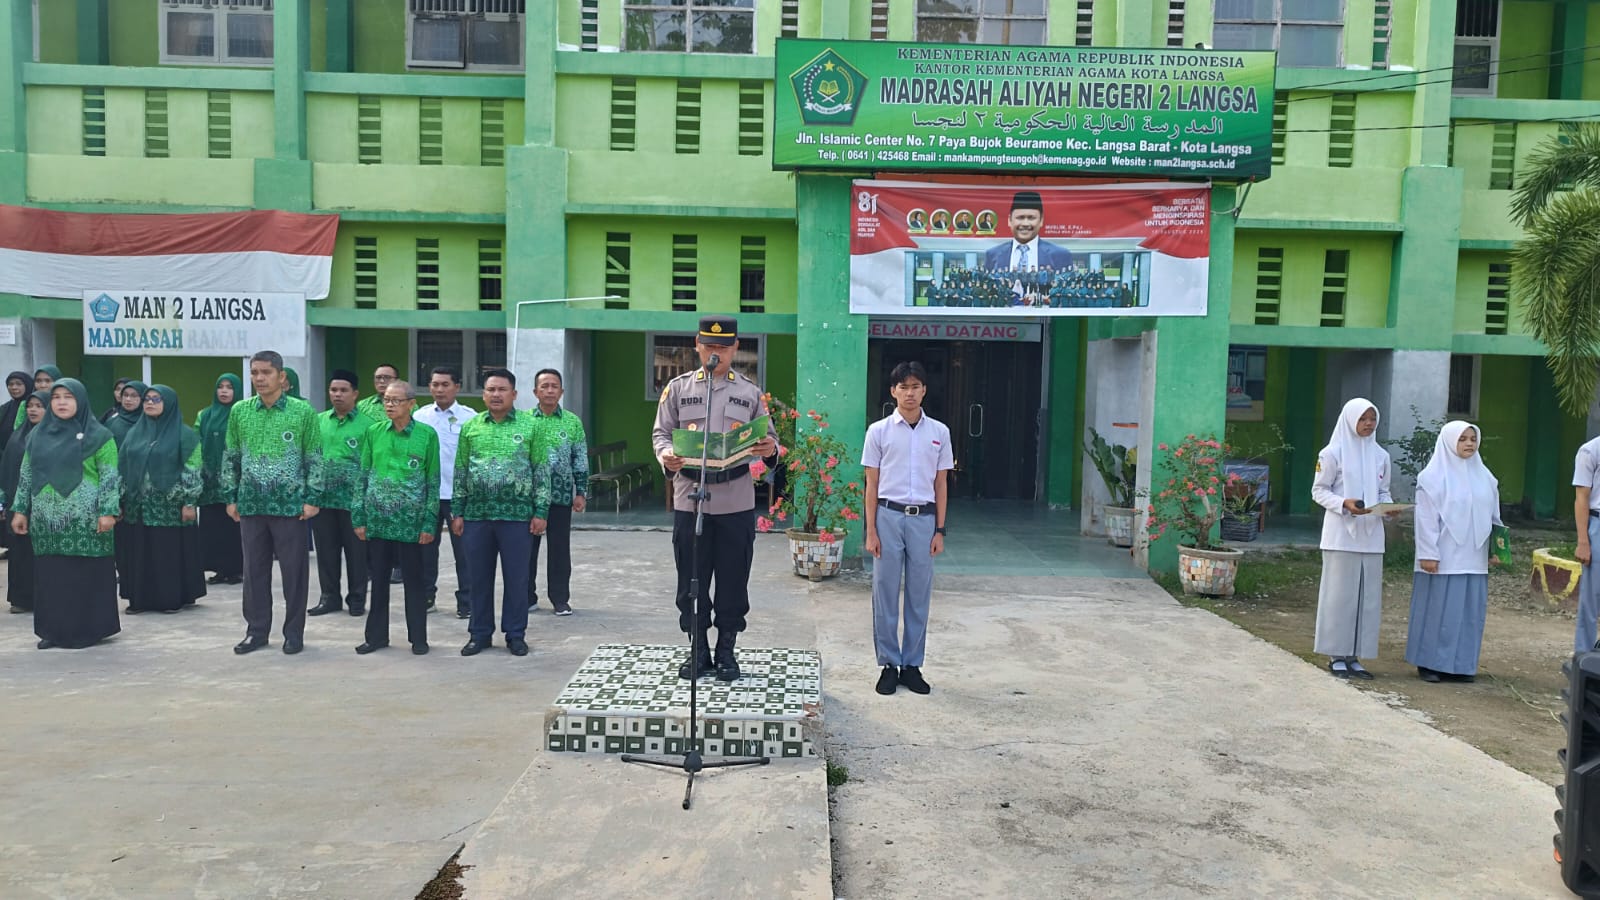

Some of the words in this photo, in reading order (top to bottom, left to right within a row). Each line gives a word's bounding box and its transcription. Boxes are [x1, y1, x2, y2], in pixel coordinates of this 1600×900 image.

[897, 48, 1012, 62] KEMENTERIAN
[1016, 51, 1072, 64] AGAMA
[1077, 52, 1155, 66] REPUBLIK
[1160, 54, 1245, 68] INDONESIA
[914, 63, 970, 75] KANTOR
[976, 64, 1074, 77] KEMENTERIAN
[1078, 67, 1126, 79] AGAMA
[1131, 68, 1168, 80] KOTA
[1173, 70, 1225, 82] LANGSA
[880, 77, 993, 106] MADRASAH
[998, 80, 1072, 108] ALIYAH
[1077, 82, 1153, 110] NEGERI
[1158, 83, 1171, 111] 2
[1176, 85, 1258, 113] LANGSA
[974, 111, 986, 127] ٢
[994, 109, 1077, 135] الحكومية
[1083, 113, 1135, 134] العالية
[795, 132, 816, 144] Jln.
[820, 133, 861, 145] Islamic
[864, 133, 903, 146] Center
[906, 134, 925, 146] No.
[928, 135, 936, 146] 7
[938, 135, 967, 150] Paya
[969, 136, 1002, 150] Bujok
[1005, 136, 1063, 149] Beuramoe
[1066, 138, 1092, 149] Kec.
[1095, 139, 1136, 153] Langsa
[1139, 139, 1171, 152] Barat
[1181, 141, 1207, 153] Kota
[1211, 142, 1252, 157] Langsa
[818, 149, 839, 161] Telp.
[847, 150, 869, 160] 0641
[877, 150, 909, 161] 425468
[911, 151, 936, 162] Email
[1111, 156, 1147, 167] Website
[1153, 157, 1236, 170] man2langsa.sch.id
[858, 191, 879, 215] 81
[1145, 219, 1168, 227] UNTUK
[123, 296, 166, 320] MAN
[172, 296, 184, 320] 2
[190, 297, 266, 321] LANGSA
[88, 327, 183, 349] MADRASAH
[188, 329, 249, 350] RAMAH
[868, 323, 941, 337] ELAMAT
[946, 325, 1018, 339] DATANG
[680, 396, 703, 405] RUDI
[728, 396, 750, 408] POLRI
